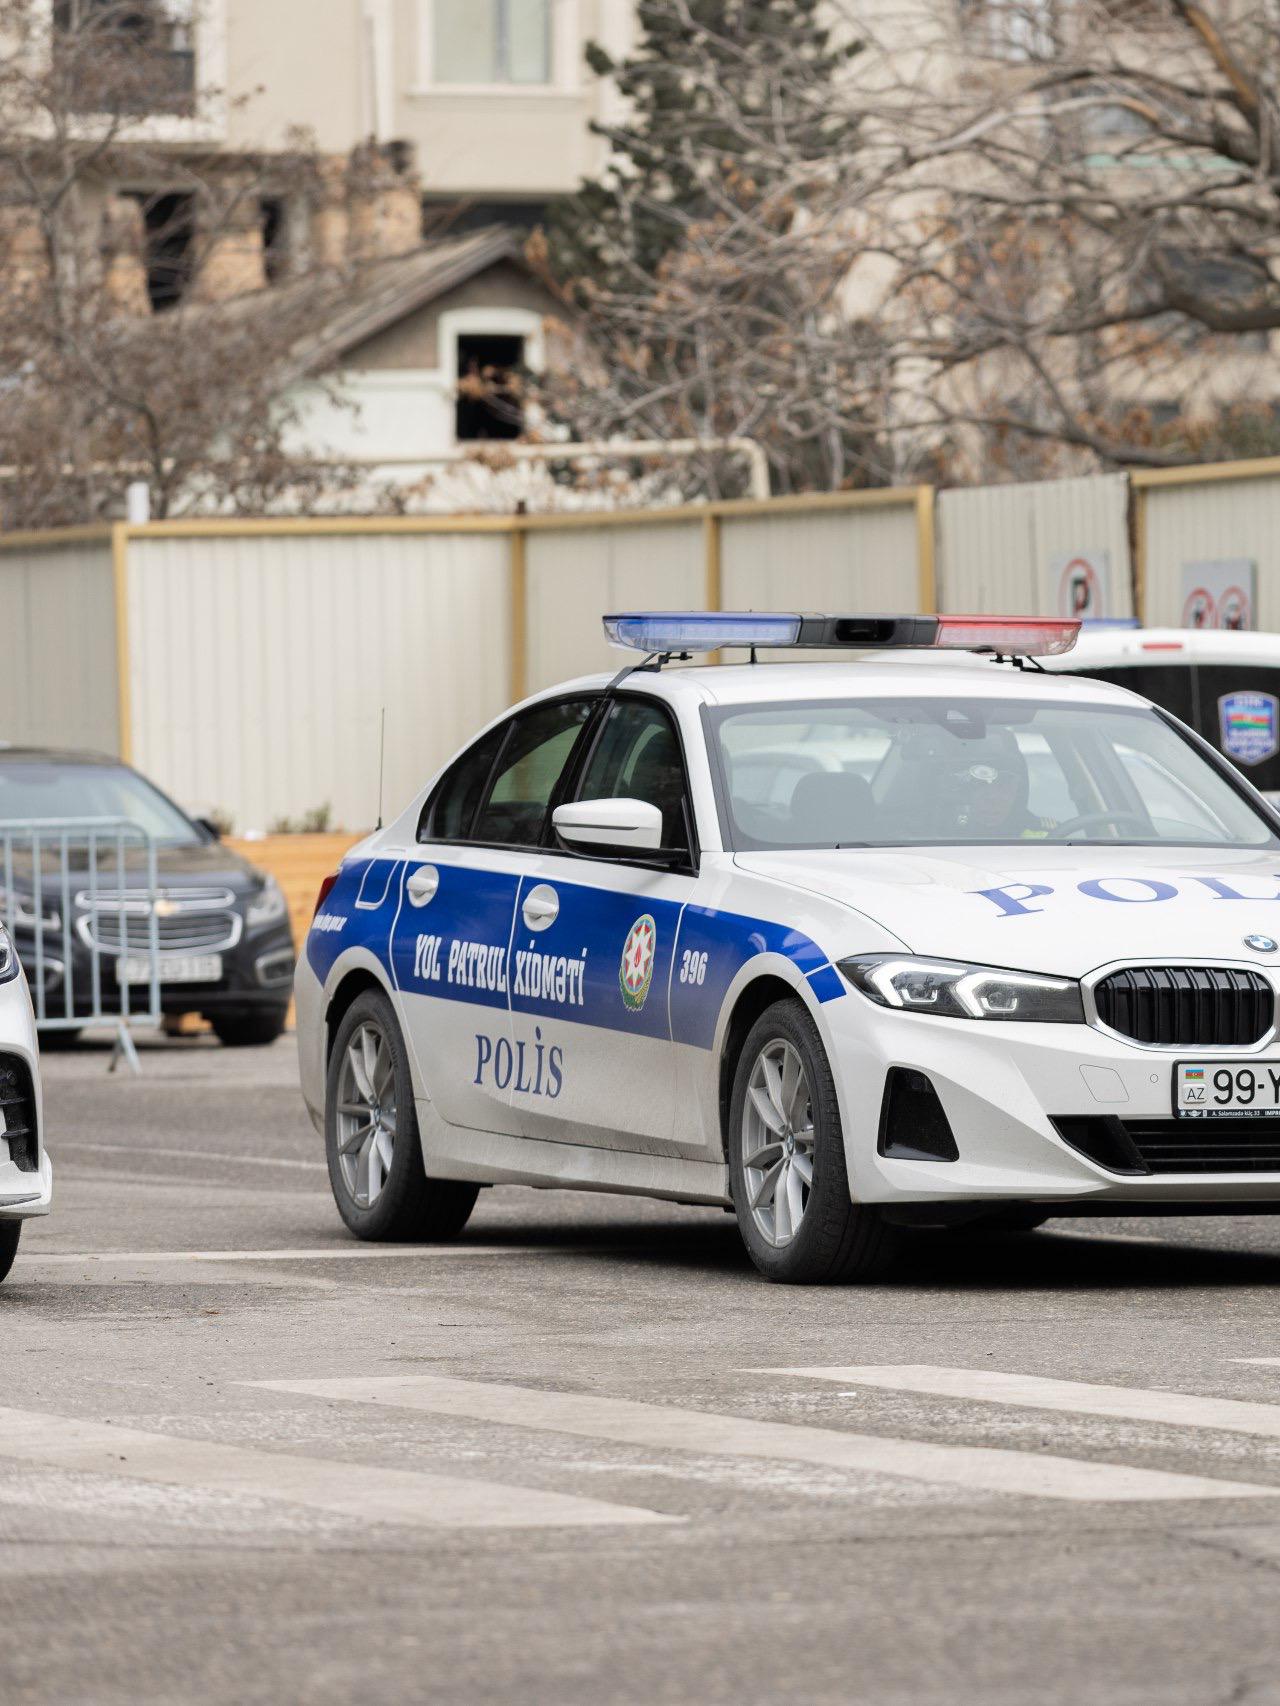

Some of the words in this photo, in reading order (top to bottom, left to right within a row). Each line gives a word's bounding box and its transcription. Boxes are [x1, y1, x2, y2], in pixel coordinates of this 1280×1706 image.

[413, 933, 442, 981] YOL
[447, 939, 507, 993] PATRUL
[680, 949, 708, 985] 396
[473, 1026, 563, 1098] POLİS
[1186, 1087, 1205, 1100] AZ
